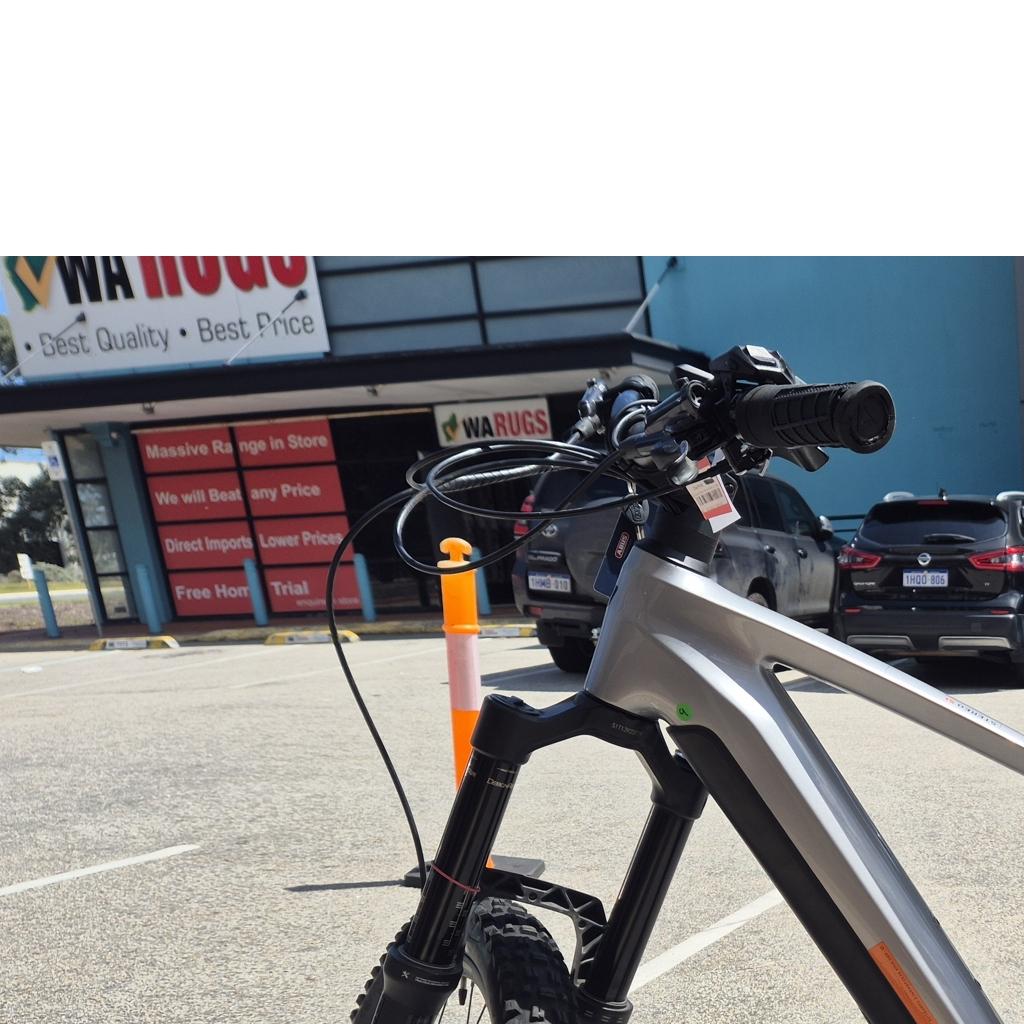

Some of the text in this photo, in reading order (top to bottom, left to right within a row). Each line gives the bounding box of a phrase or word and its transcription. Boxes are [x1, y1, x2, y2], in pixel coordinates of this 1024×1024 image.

[39, 311, 316, 358] Best Quality Best Price
[145, 441, 209, 460] Massive
[270, 436, 285, 450] in
[287, 433, 328, 449] Store
[154, 483, 321, 506] We will Beat any Price
[164, 531, 345, 554] Direct Imports Lower Prices
[175, 580, 310, 600] Free Hom Trial
